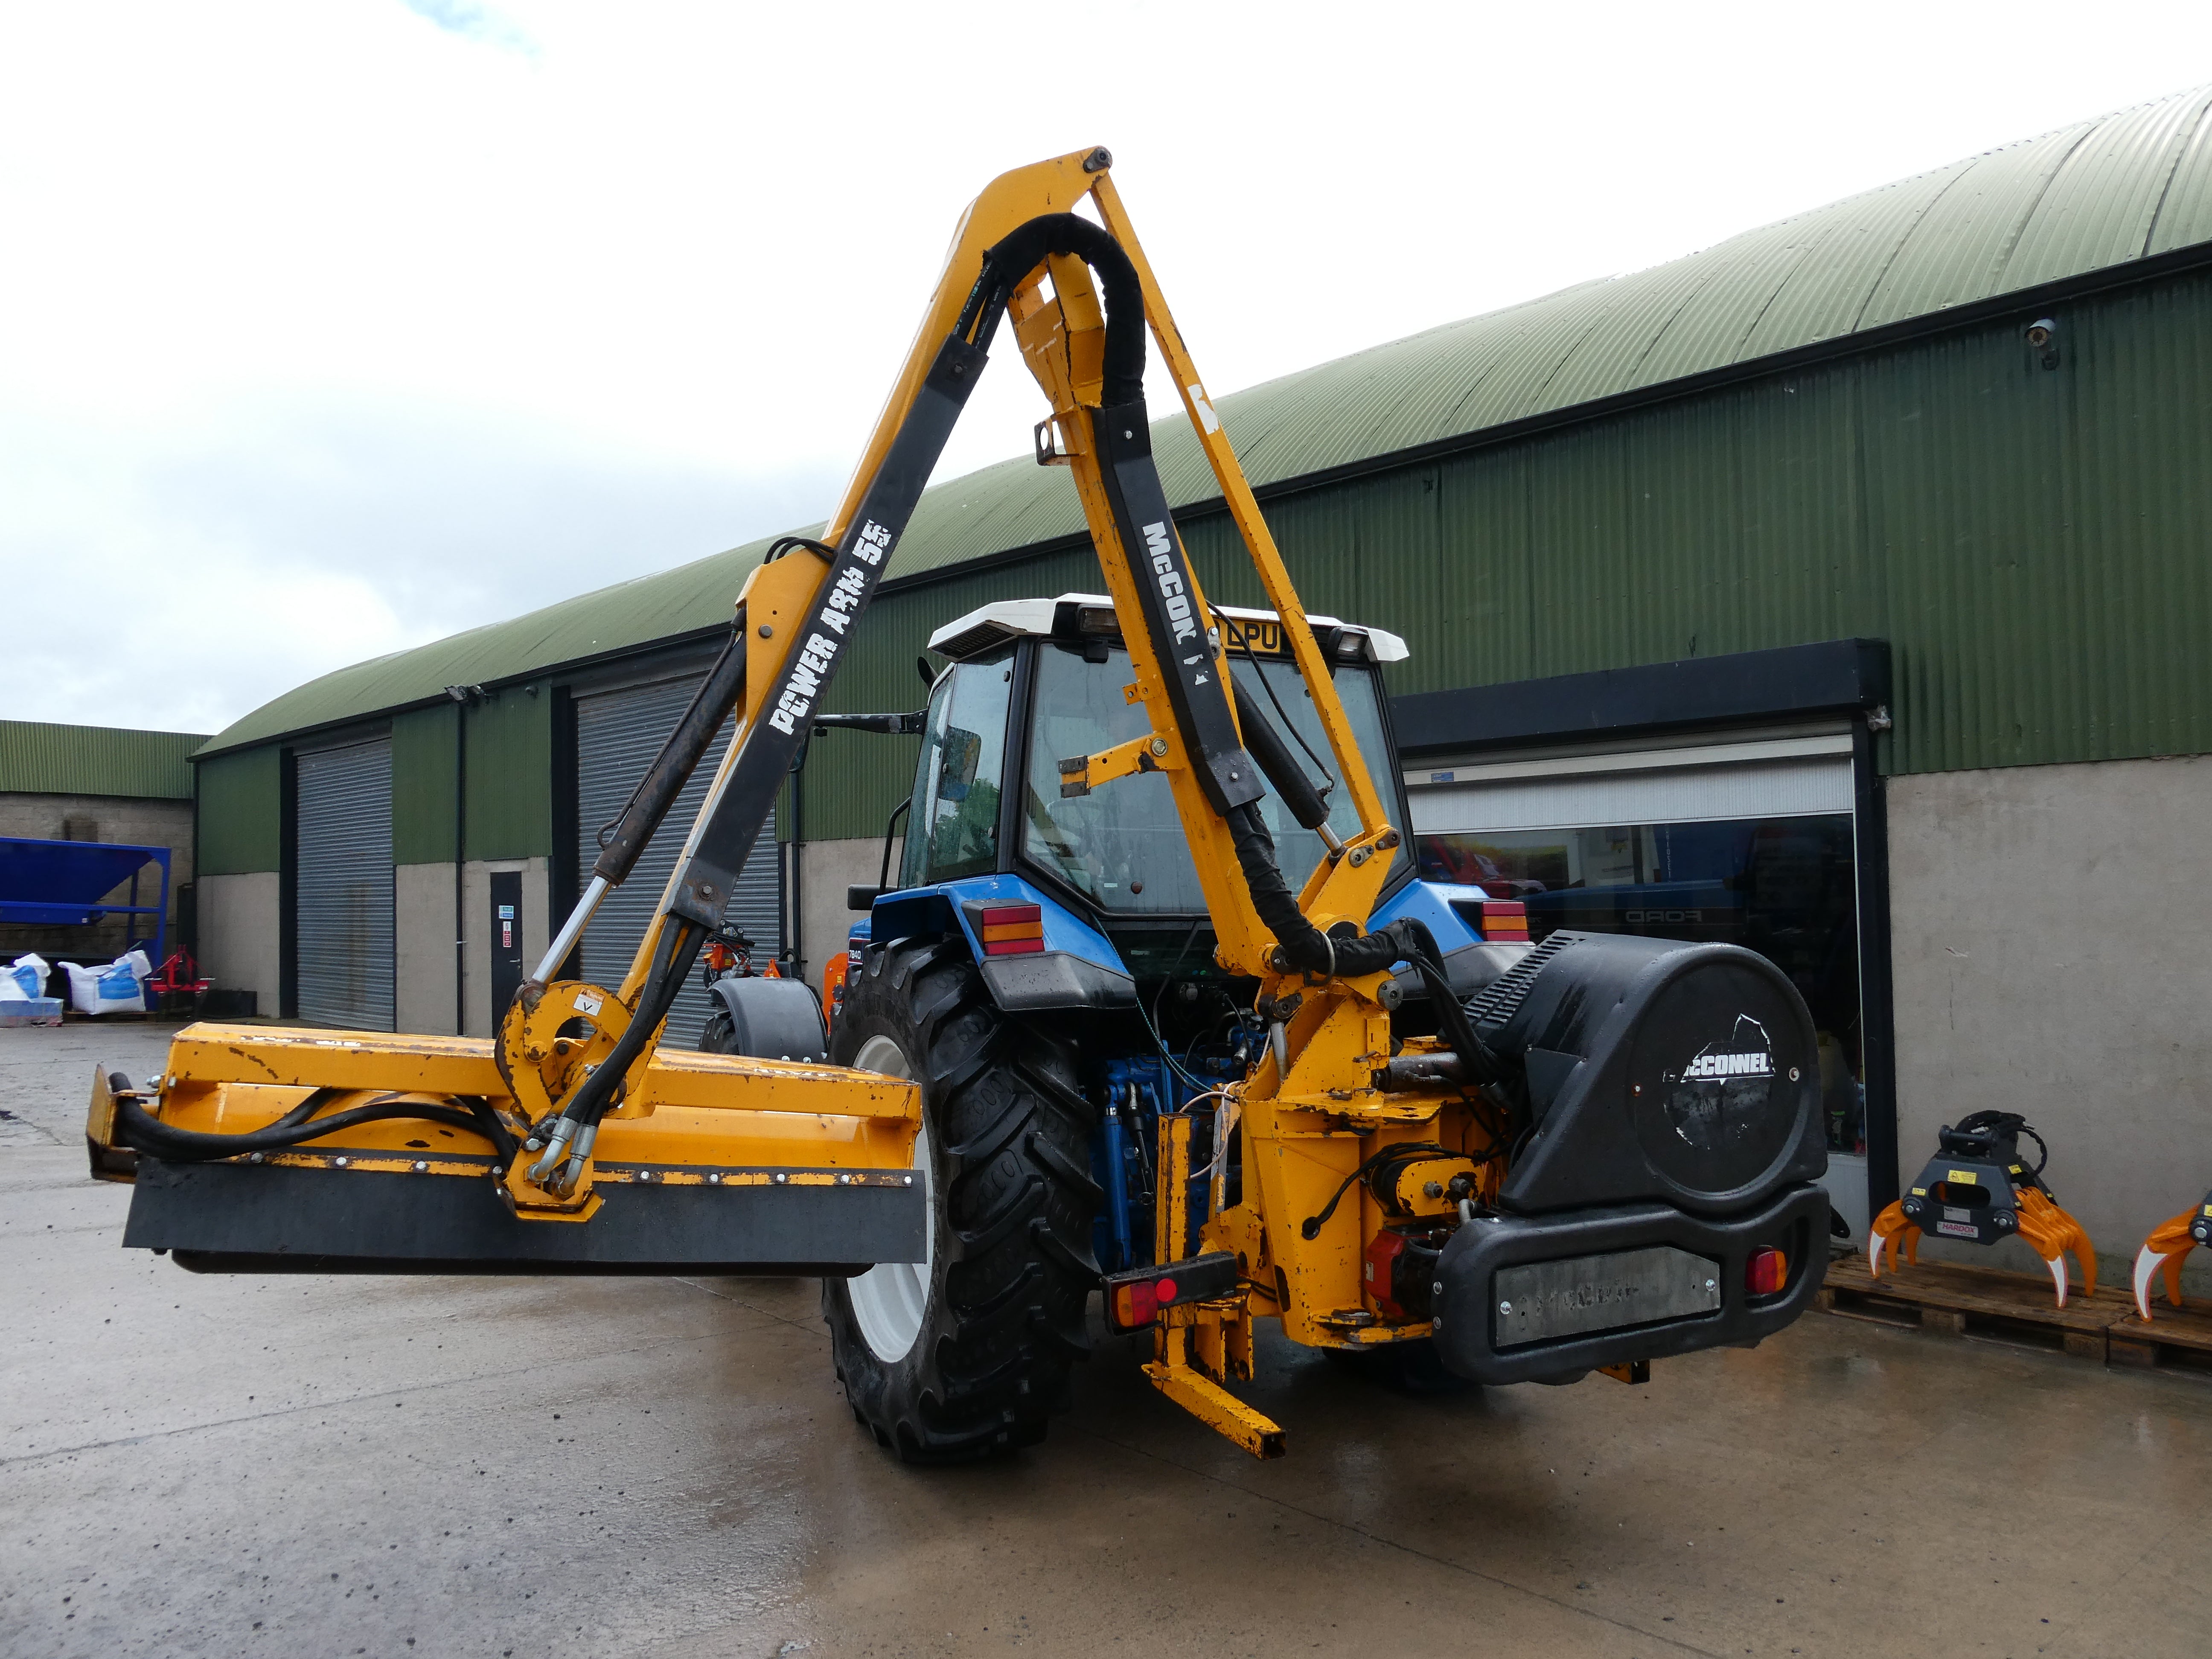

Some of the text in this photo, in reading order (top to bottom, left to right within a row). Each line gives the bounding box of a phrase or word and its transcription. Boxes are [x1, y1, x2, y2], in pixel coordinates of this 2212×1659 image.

[769, 519, 892, 735] POWER ARM 55
[1228, 623, 1278, 649] LPU
[849, 950, 861, 959] 7840
[1683, 1053, 1769, 1076] cCONNEL
[1942, 1223, 1974, 1233] HARDOX
